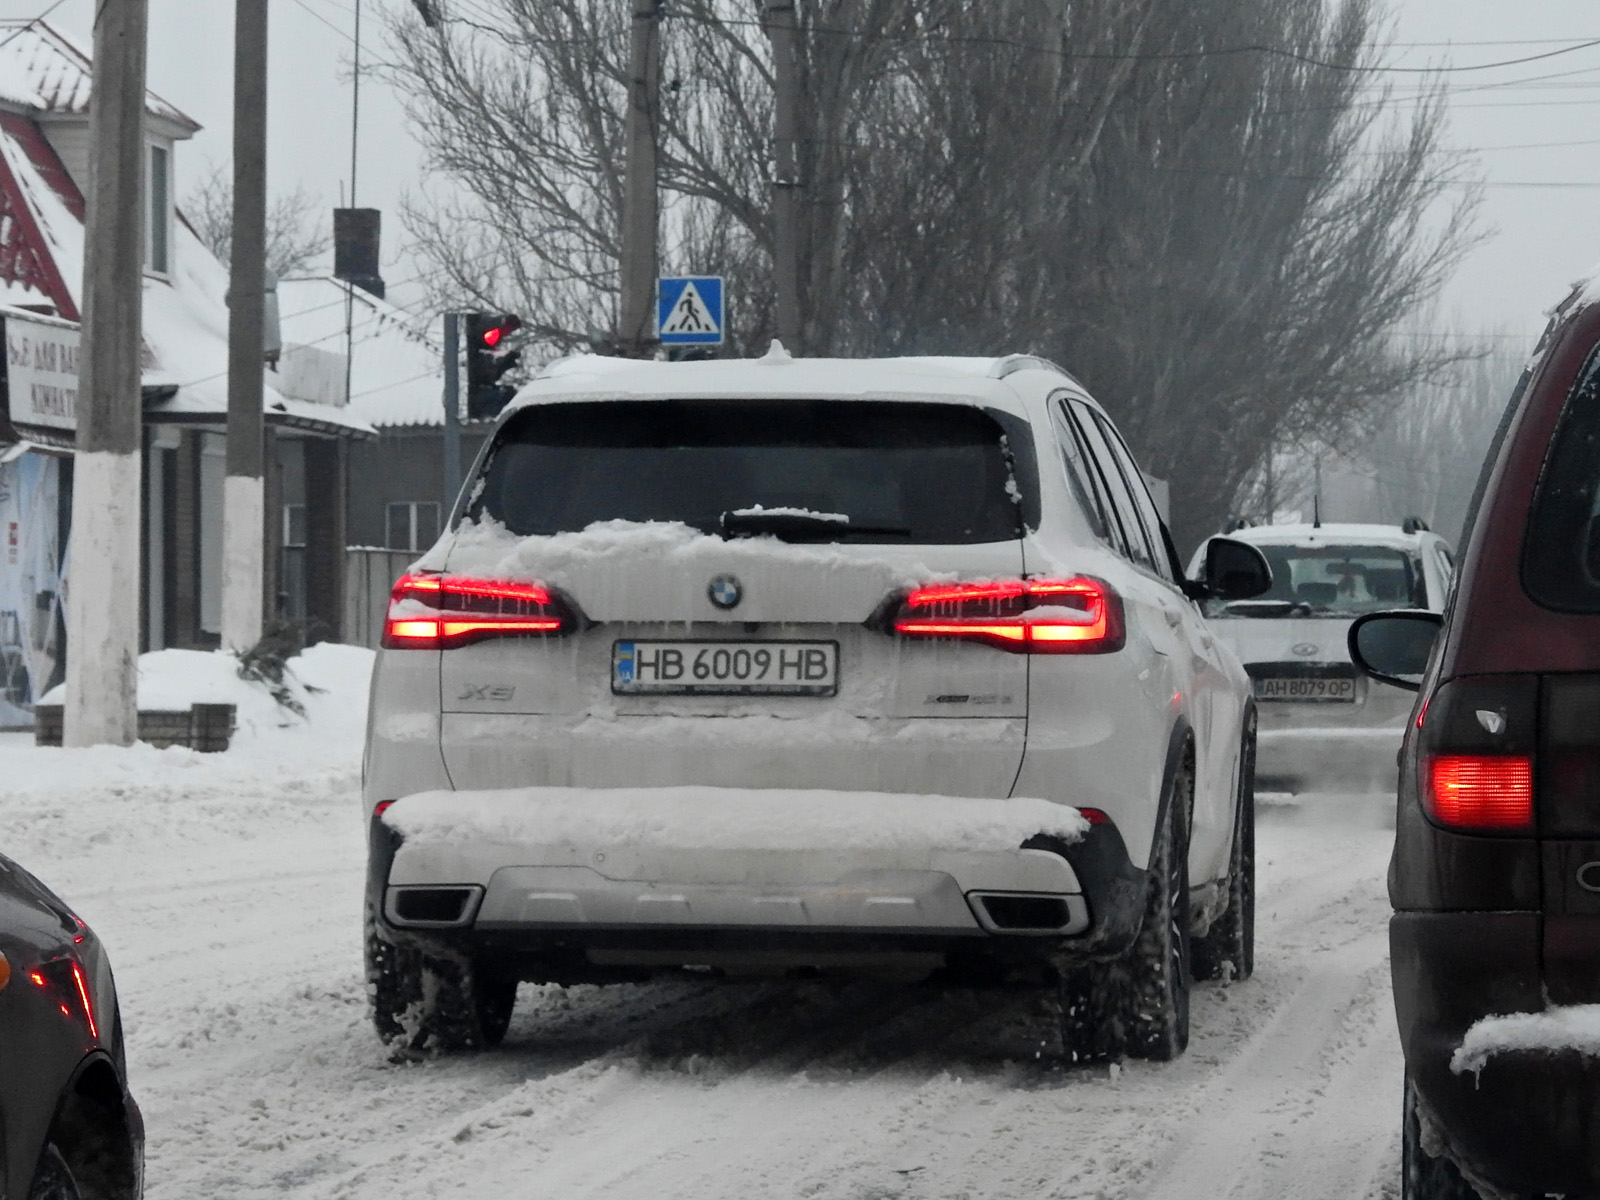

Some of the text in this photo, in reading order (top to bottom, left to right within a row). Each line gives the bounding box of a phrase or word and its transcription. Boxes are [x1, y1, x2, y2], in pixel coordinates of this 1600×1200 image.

[636, 649, 828, 680] HB 6009 HB
[1265, 681, 1351, 696] AH 8079 OP
